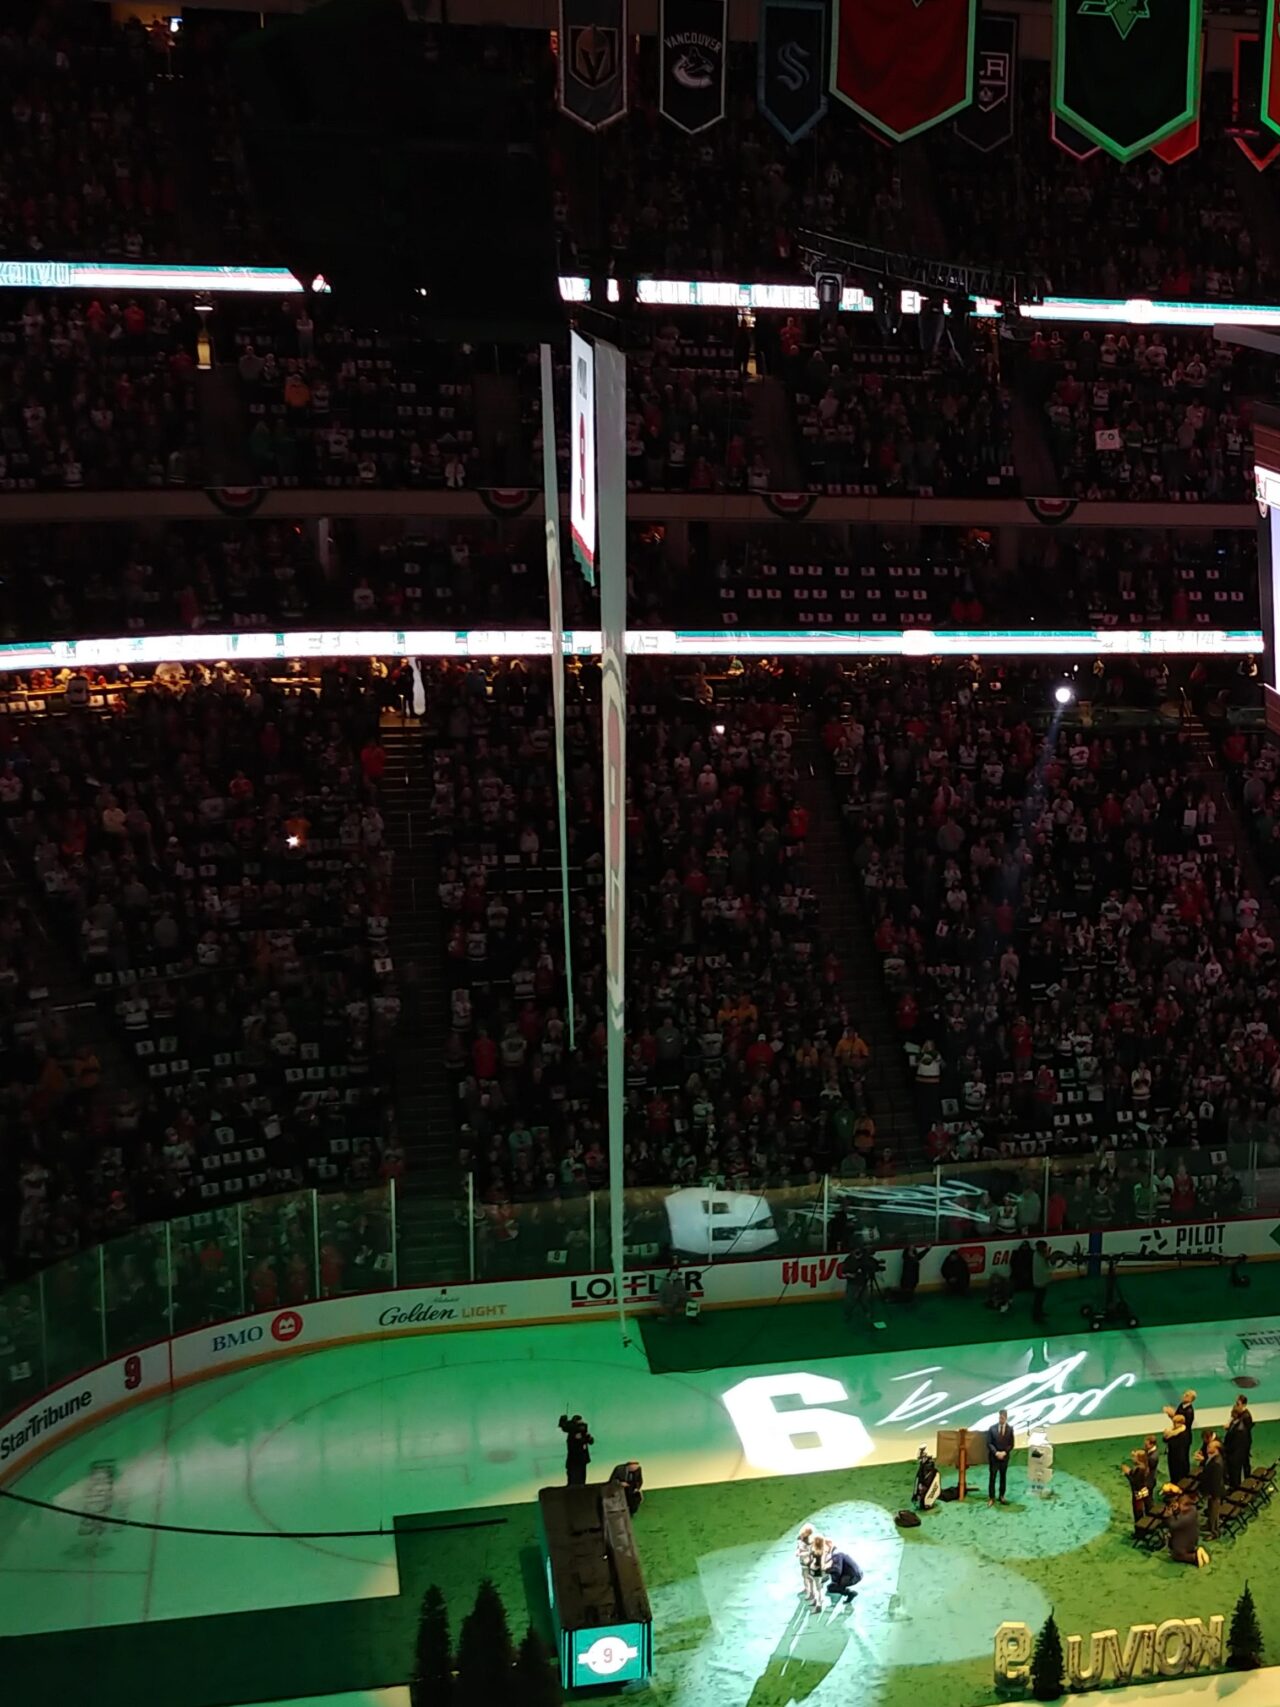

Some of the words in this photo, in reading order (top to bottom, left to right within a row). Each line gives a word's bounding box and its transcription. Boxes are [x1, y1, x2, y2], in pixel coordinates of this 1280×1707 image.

[664, 32, 722, 53] VANCOUVER
[1176, 1224, 1227, 1248] PILOT
[571, 1271, 704, 1301] LOFLR
[782, 1258, 847, 1288] HyV
[379, 1303, 459, 1327] Golden
[462, 1304, 508, 1319] LIGHT
[213, 1326, 264, 1353] BMO
[124, 1356, 142, 1390] 9
[0, 1390, 93, 1460] StarTribune
